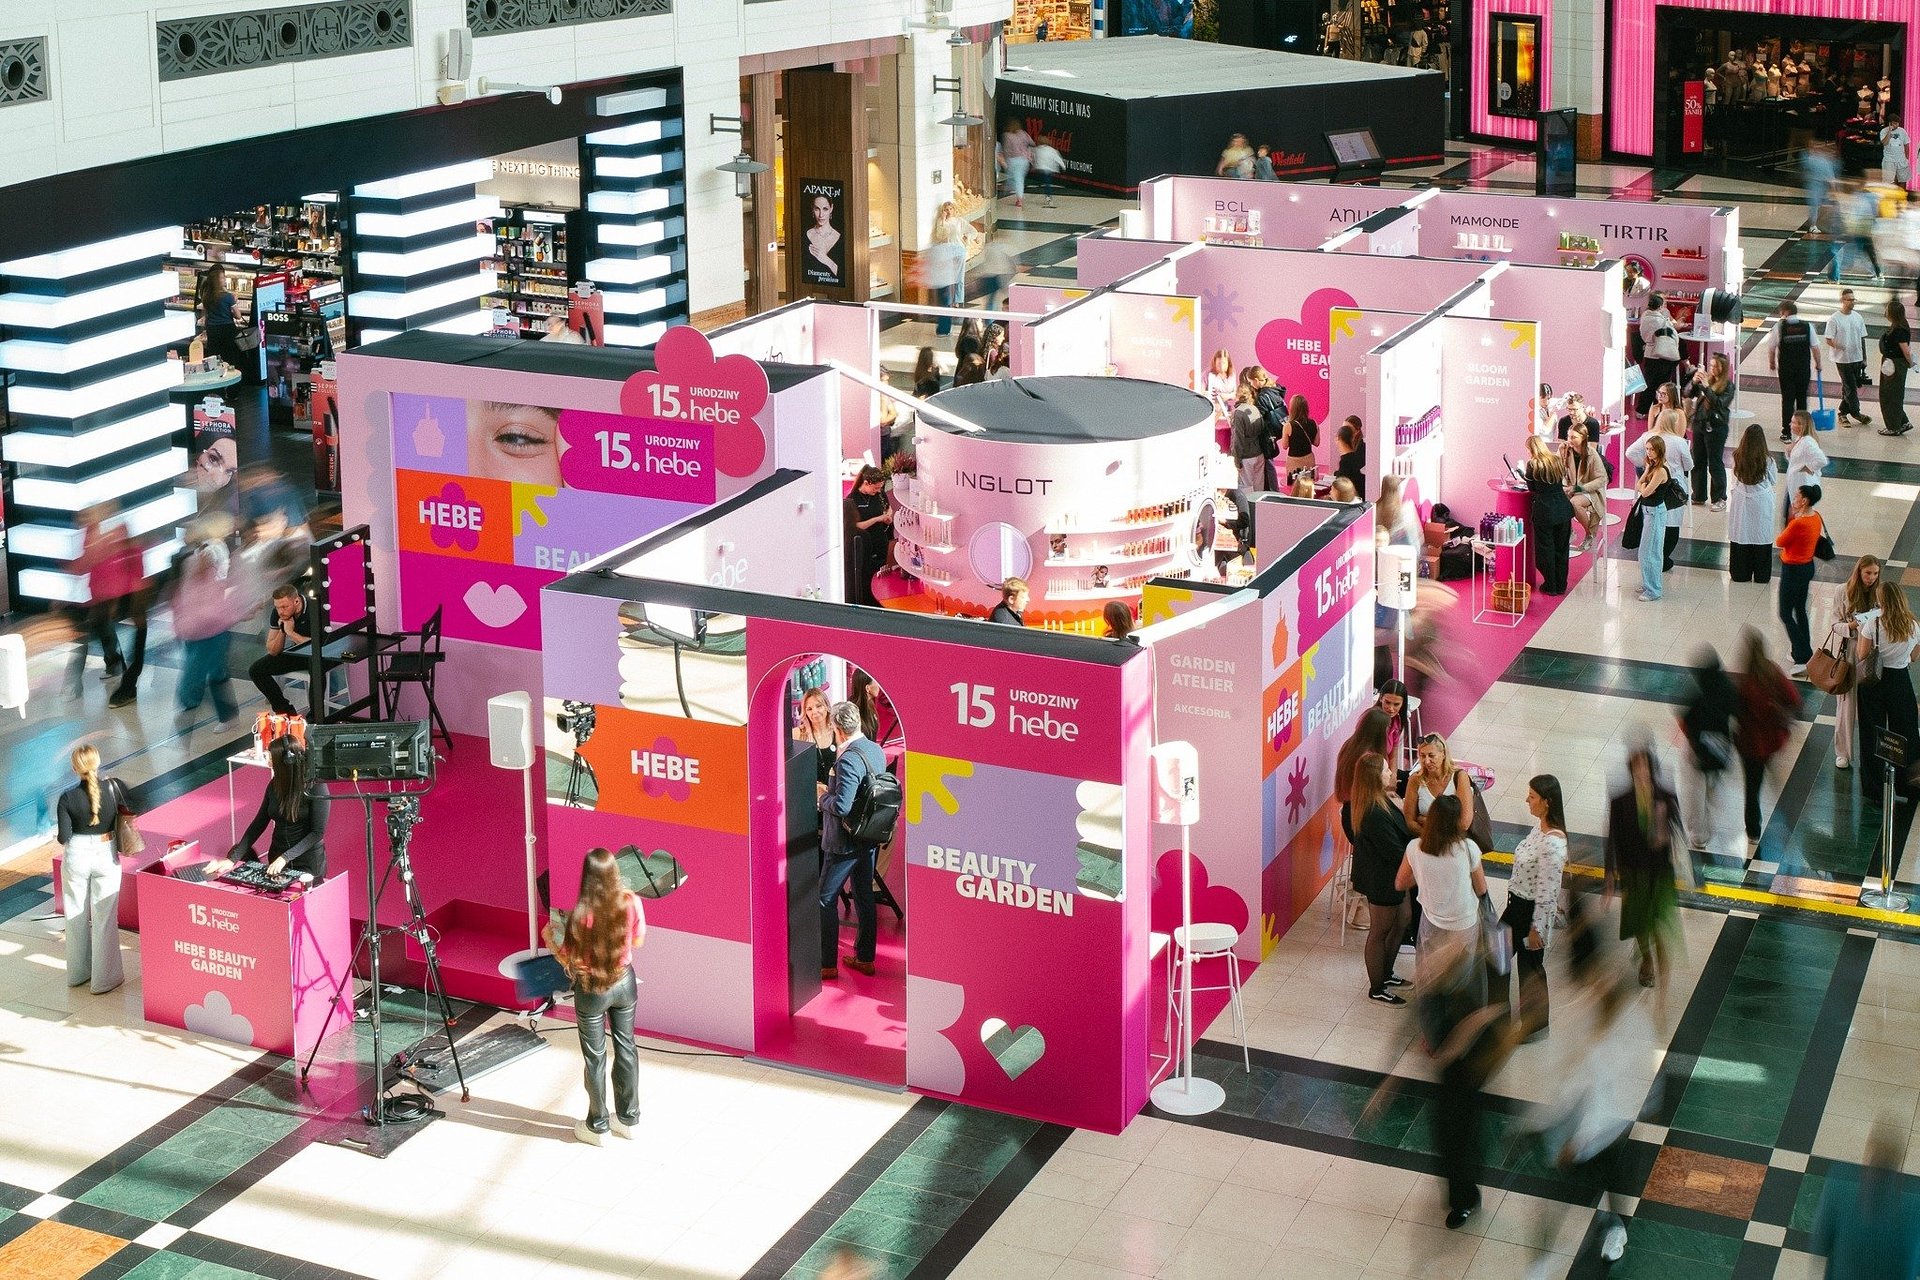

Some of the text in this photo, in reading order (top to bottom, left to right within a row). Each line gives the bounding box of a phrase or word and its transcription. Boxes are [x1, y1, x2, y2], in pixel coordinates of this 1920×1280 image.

[1011, 92, 1091, 118] ZMIENIAMY SIĘ DLA WAS
[500, 161, 525, 175] NEXT
[1215, 200, 1249, 213] BCL
[1451, 215, 1520, 229] MAMONDE
[1600, 223, 1669, 242] TIRTIR
[267, 312, 290, 323] BOSS
[1286, 338, 1322, 352] HEBE
[1465, 376, 1511, 388] GARDEN
[647, 383, 740, 419] 15. URODZINY
[690, 399, 741, 424] hebe
[201, 420, 232, 430] SEPHORA
[594, 430, 701, 472] 15. URODZINY
[645, 448, 702, 478] hebe
[956, 470, 1053, 496] INGLOT
[418, 500, 482, 532] HEBE
[1315, 565, 1360, 619] 15. hebe
[1170, 654, 1236, 675] GARDEN
[1171, 673, 1235, 693] ATELIER
[950, 682, 1080, 728] 15 URODZINY
[1174, 703, 1232, 720] AKCESORIA
[1267, 690, 1299, 744] HEBE
[1009, 705, 1079, 742] hebe
[630, 749, 701, 785] HEBE
[927, 845, 1037, 886] BEAUTY
[956, 874, 1074, 917] GARDEN
[188, 903, 239, 928] 15. URODZINY
[211, 915, 240, 934] hebe
[174, 940, 257, 970] HEBE BEAUTY
[191, 958, 242, 981] GARDEN
